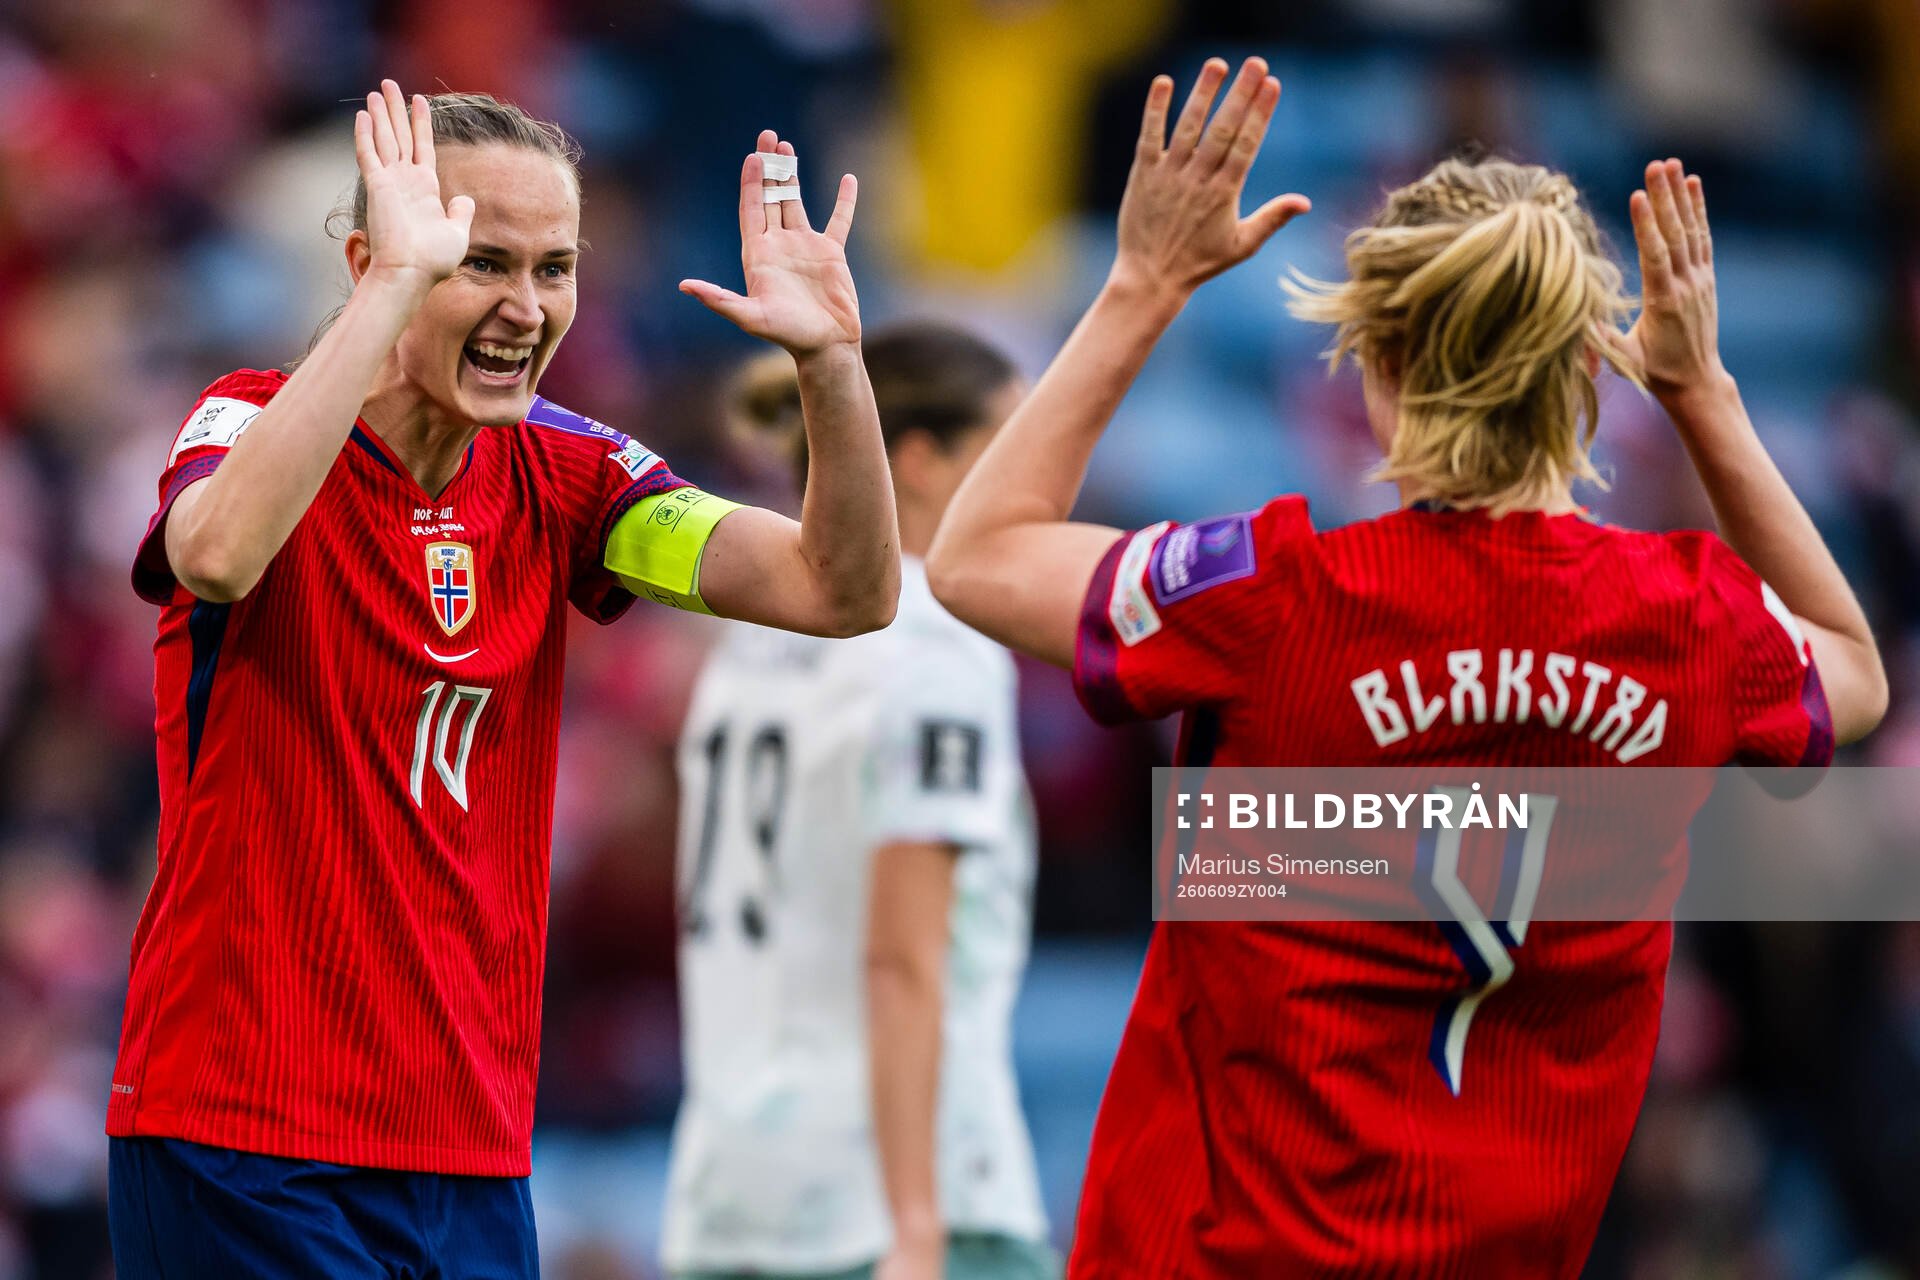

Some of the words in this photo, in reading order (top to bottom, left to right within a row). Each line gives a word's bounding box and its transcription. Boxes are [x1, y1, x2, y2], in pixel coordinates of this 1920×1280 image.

[413, 508, 432, 520] NOR
[439, 507, 453, 519] AUT
[441, 548, 455, 557] NORGE
[1350, 648, 1668, 765] BLAKSTAD
[410, 681, 493, 813] 10
